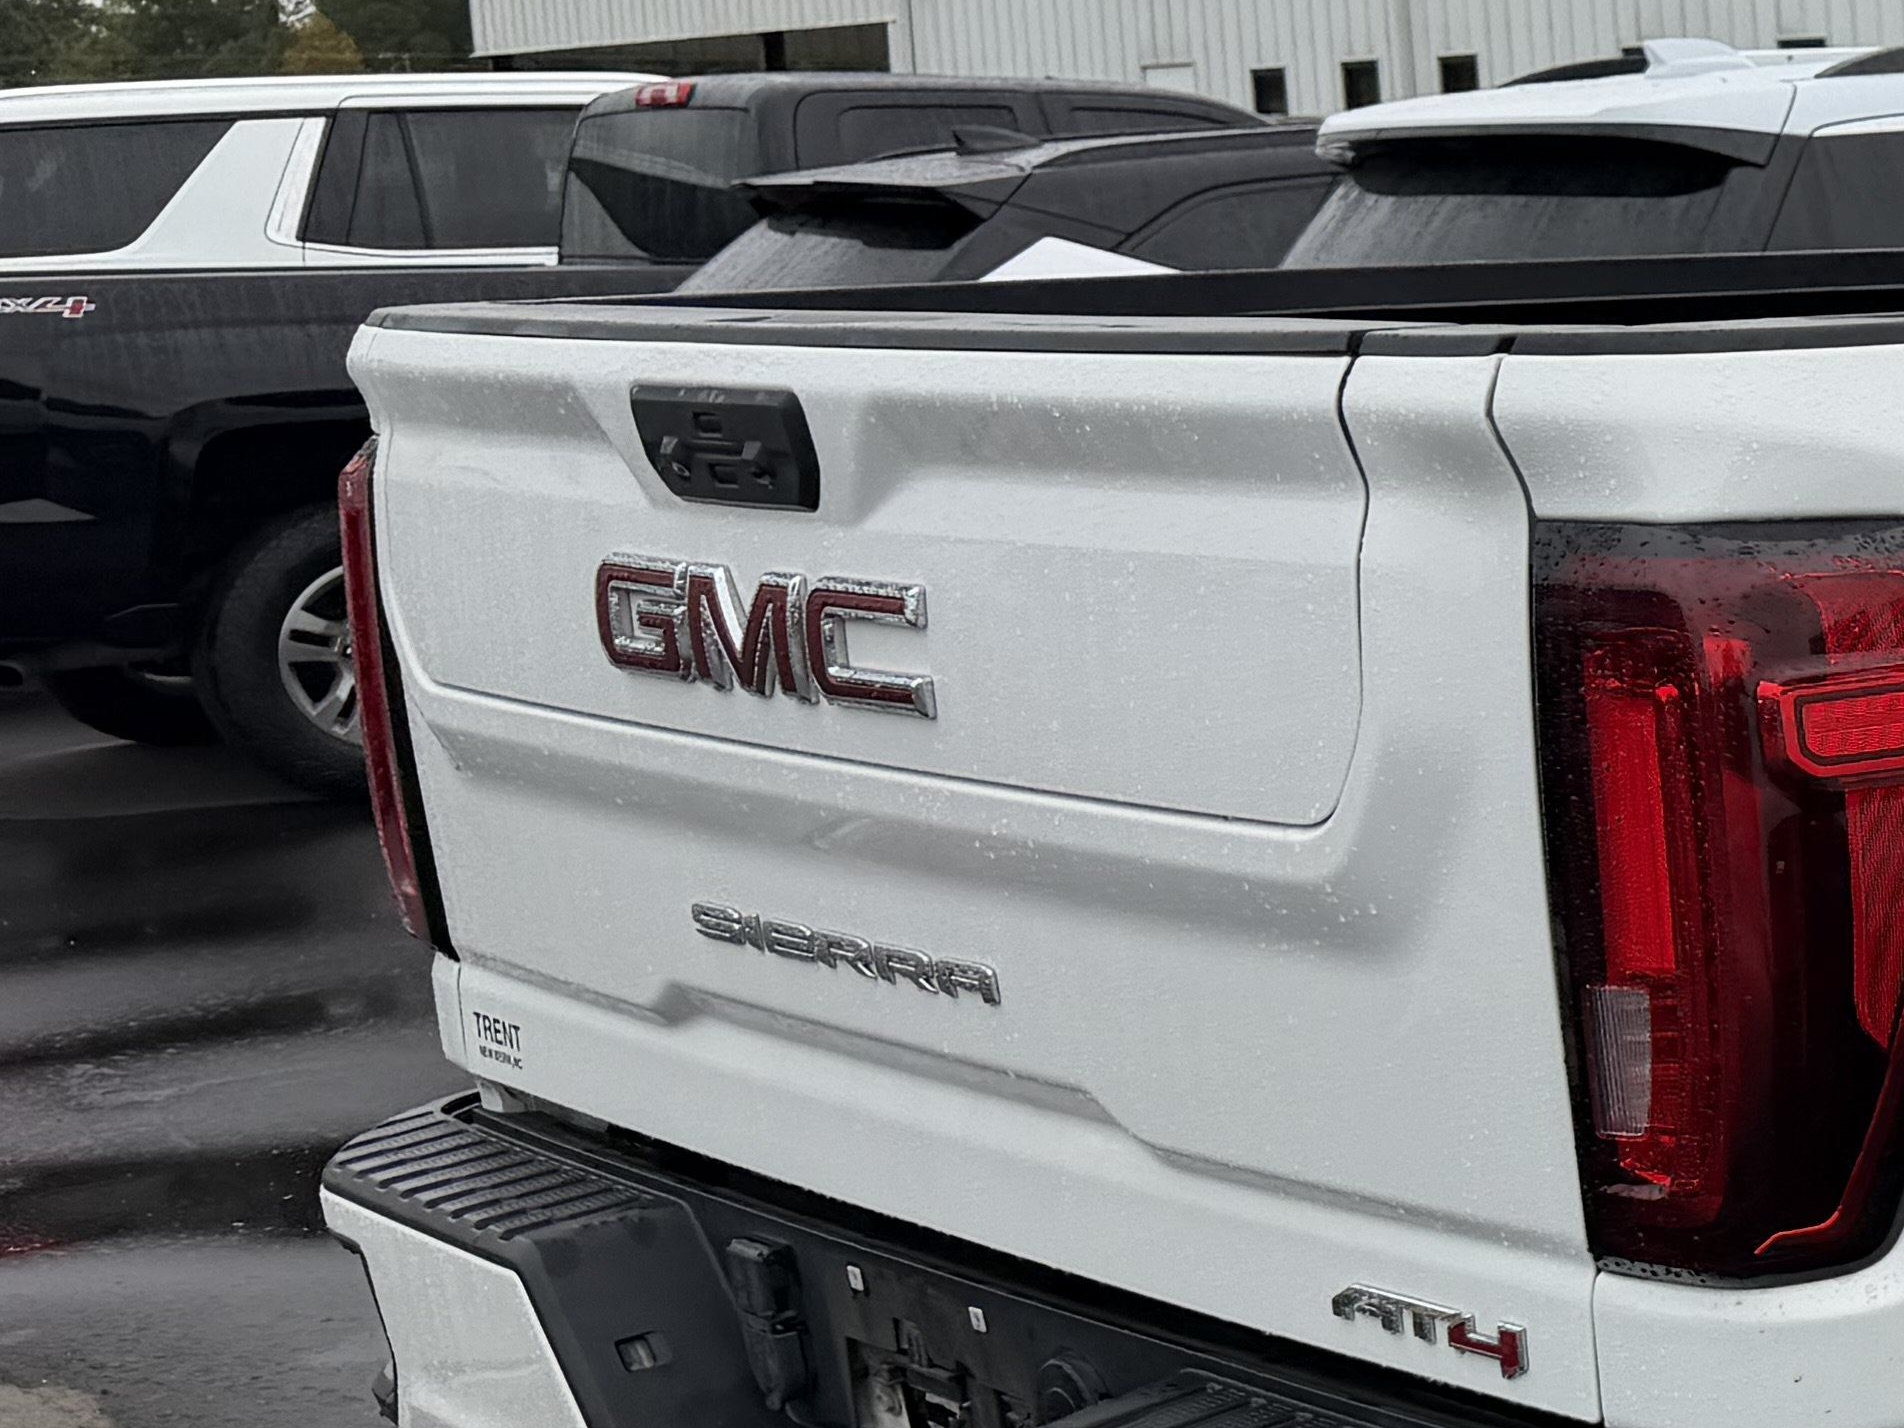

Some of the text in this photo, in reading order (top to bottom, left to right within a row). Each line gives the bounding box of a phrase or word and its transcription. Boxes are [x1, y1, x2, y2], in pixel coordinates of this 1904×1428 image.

[594, 551, 938, 720] GMC
[691, 901, 1002, 1006] SIERRA
[473, 1011, 521, 1053] TRENT
[1332, 1283, 1530, 1380] AT4
